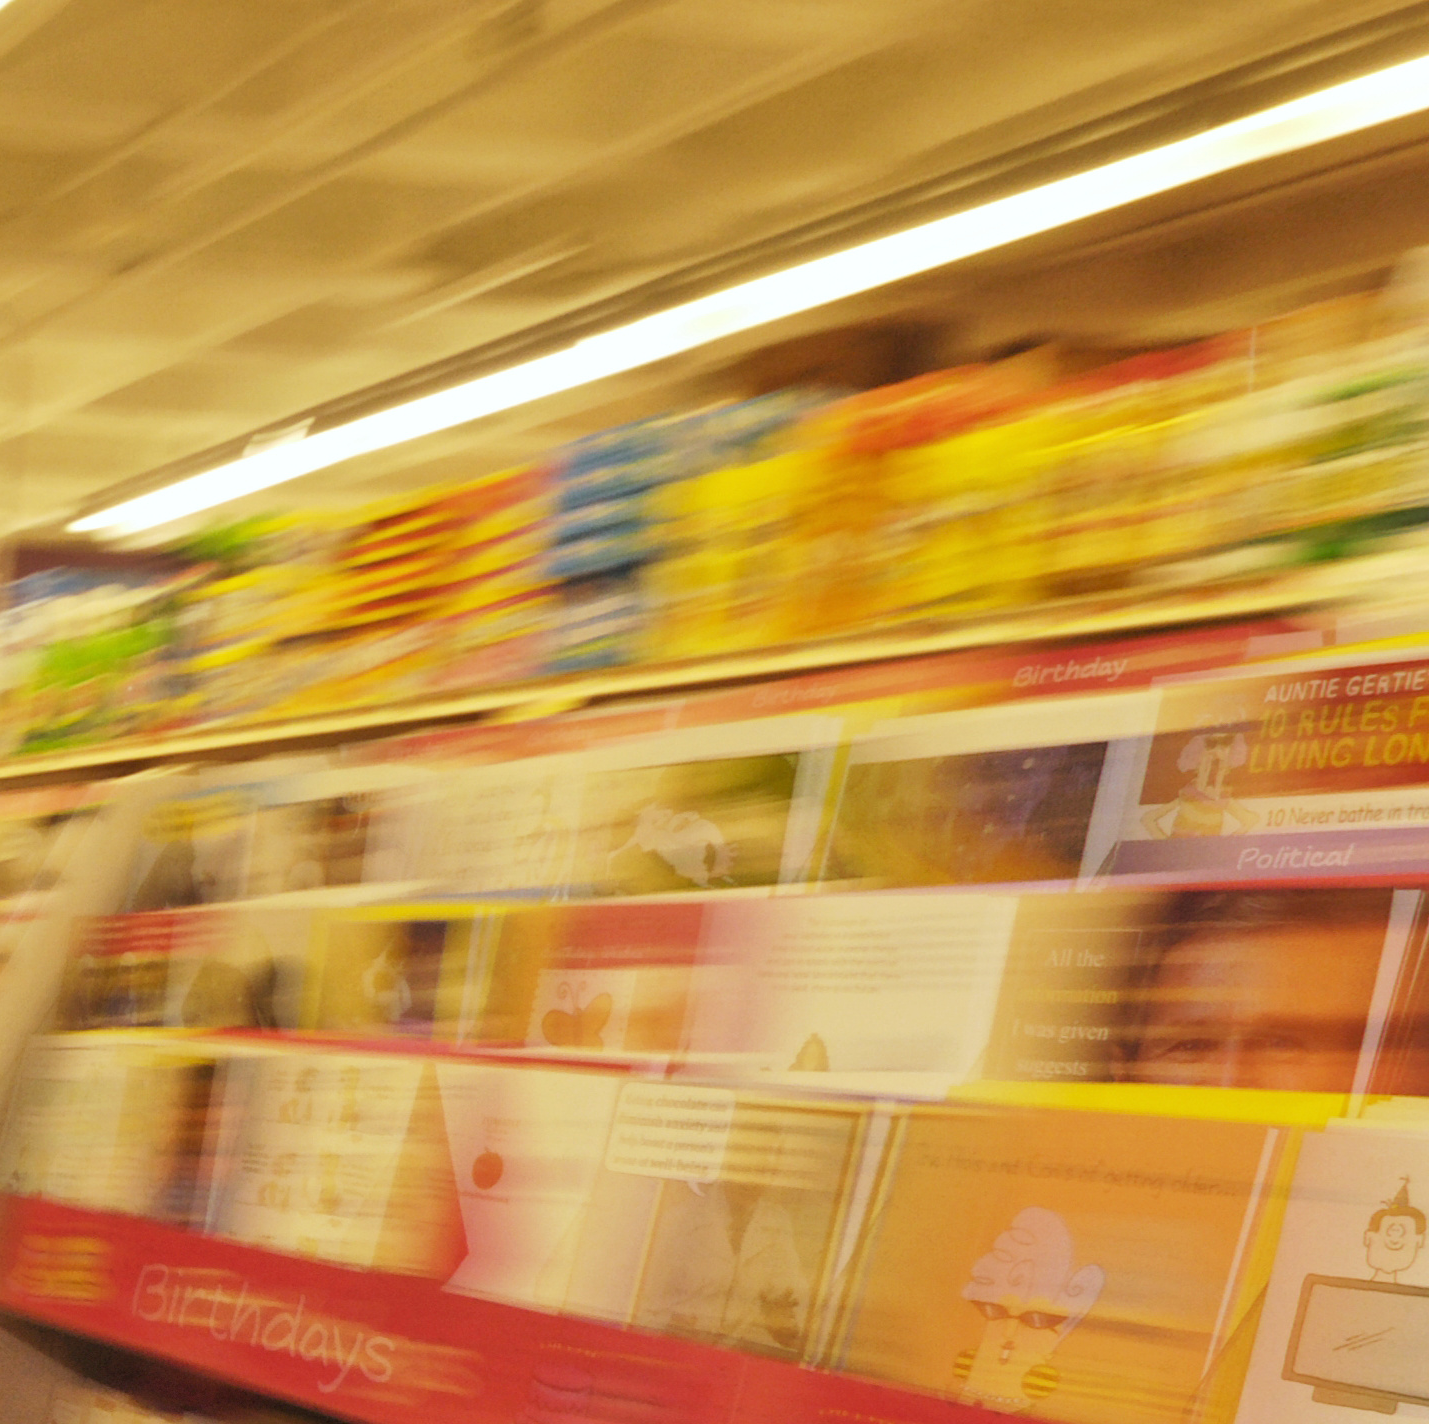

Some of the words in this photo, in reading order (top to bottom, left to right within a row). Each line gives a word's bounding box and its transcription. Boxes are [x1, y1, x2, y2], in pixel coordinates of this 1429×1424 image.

[1264, 677, 1340, 703] AUNTIE
[1297, 699, 1399, 738] RULES
[1249, 736, 1357, 774] LIVING
[1235, 842, 1356, 872] Political
[131, 1261, 396, 1393] Birthdays
